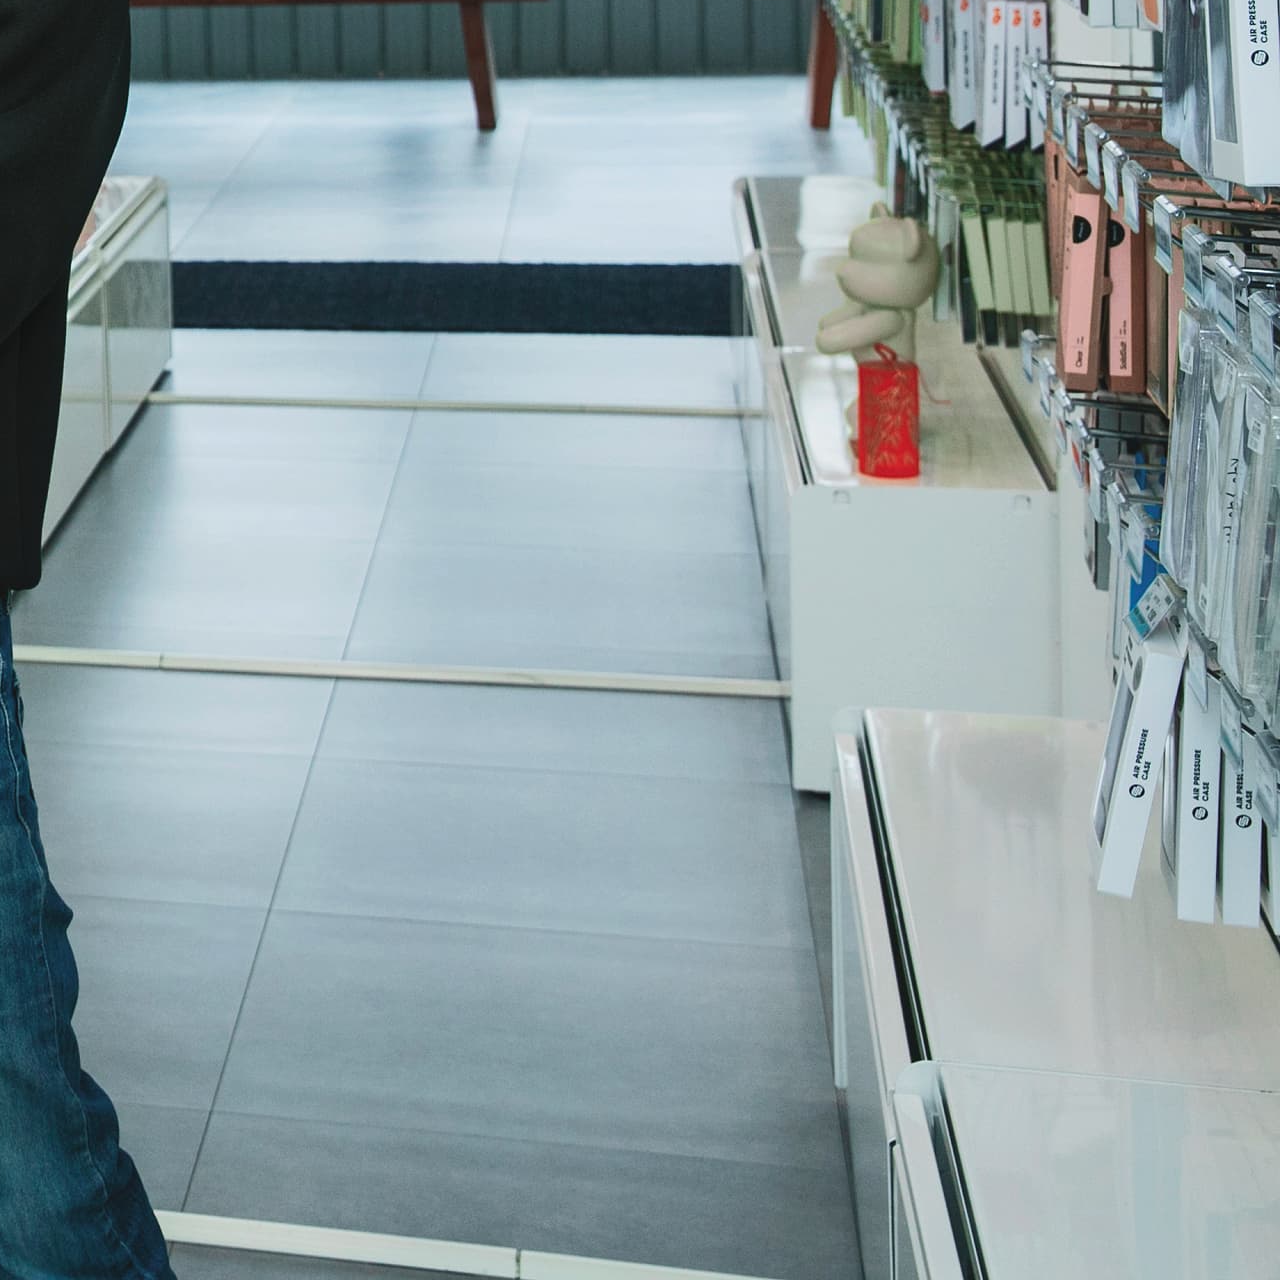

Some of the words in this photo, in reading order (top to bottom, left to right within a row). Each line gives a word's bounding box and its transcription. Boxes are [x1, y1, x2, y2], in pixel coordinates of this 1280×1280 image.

[1259, 20, 1268, 43] CASE
[1136, 728, 1149, 764] PRESSURE
[1132, 765, 1141, 779] AIR
[1141, 761, 1152, 780] CASE
[1193, 749, 1202, 783] PRESSURE
[1202, 782, 1210, 801] CASE
[1245, 791, 1253, 810] CASE
